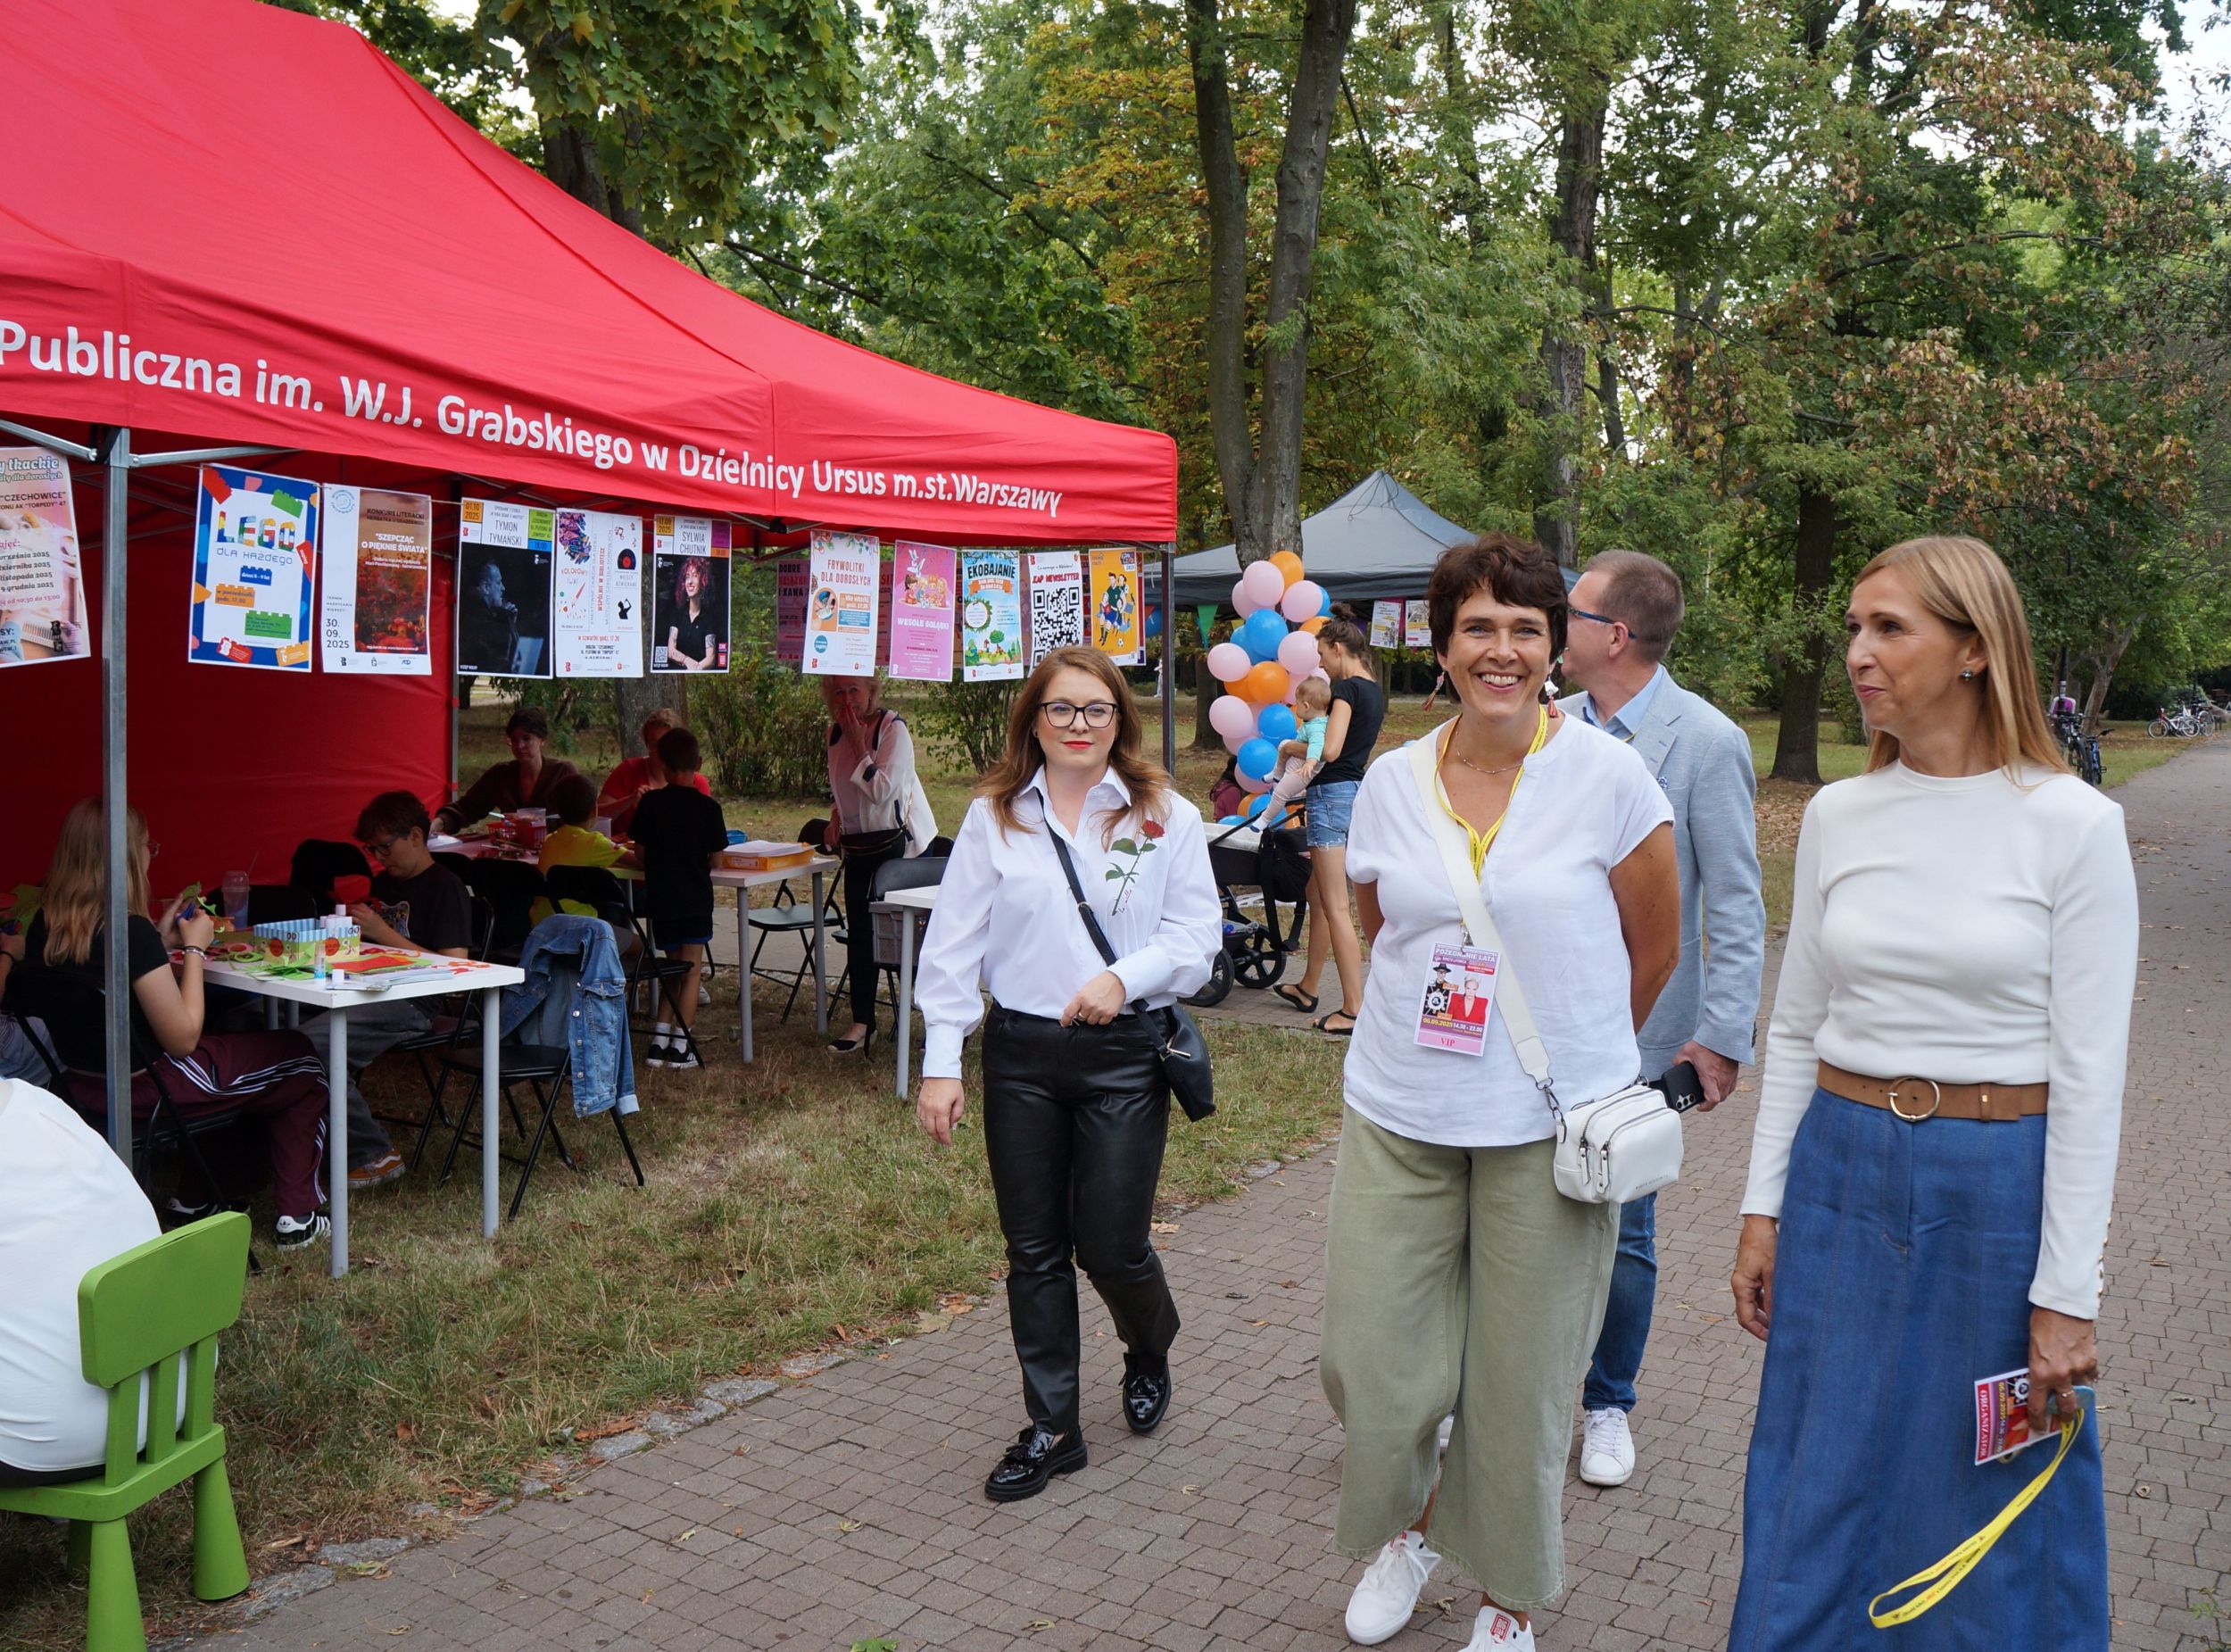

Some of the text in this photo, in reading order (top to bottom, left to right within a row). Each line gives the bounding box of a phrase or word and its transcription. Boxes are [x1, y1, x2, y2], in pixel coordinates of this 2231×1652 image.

[0, 320, 241, 398] Publiczna
[255, 359, 323, 412] im.
[339, 376, 422, 428] W.J.
[437, 394, 634, 469] Grabskiego
[641, 442, 669, 471] w
[678, 444, 805, 499] Dzielnicy
[812, 460, 887, 495] Ursus
[8, 456, 59, 471] tkackie
[367, 508, 425, 519] KONKURS LITERACKI
[465, 511, 479, 520] 2025
[216, 511, 295, 552] LEGO
[495, 519, 518, 532] TYMON
[658, 525, 672, 533] 2025
[489, 532, 522, 546] TYMAŃSKI
[682, 531, 705, 543] SYLWIA
[679, 543, 707, 555] CHUTNIK
[778, 563, 800, 573] DOBRE
[827, 559, 865, 573] FRYWOLITKI
[966, 563, 1016, 579] EKOBAJANIE
[820, 571, 834, 582] DLA
[835, 572, 872, 585] DOROSŁYCH
[1045, 572, 1080, 583] NEWSLETTER
[326, 618, 340, 627] 30.
[326, 629, 341, 637] 09.
[327, 639, 349, 649] 2025
[1478, 954, 1496, 963] LATA
[1439, 1037, 1456, 1047] VIP
[1979, 1390, 1990, 1457] ORGANIZATOR
